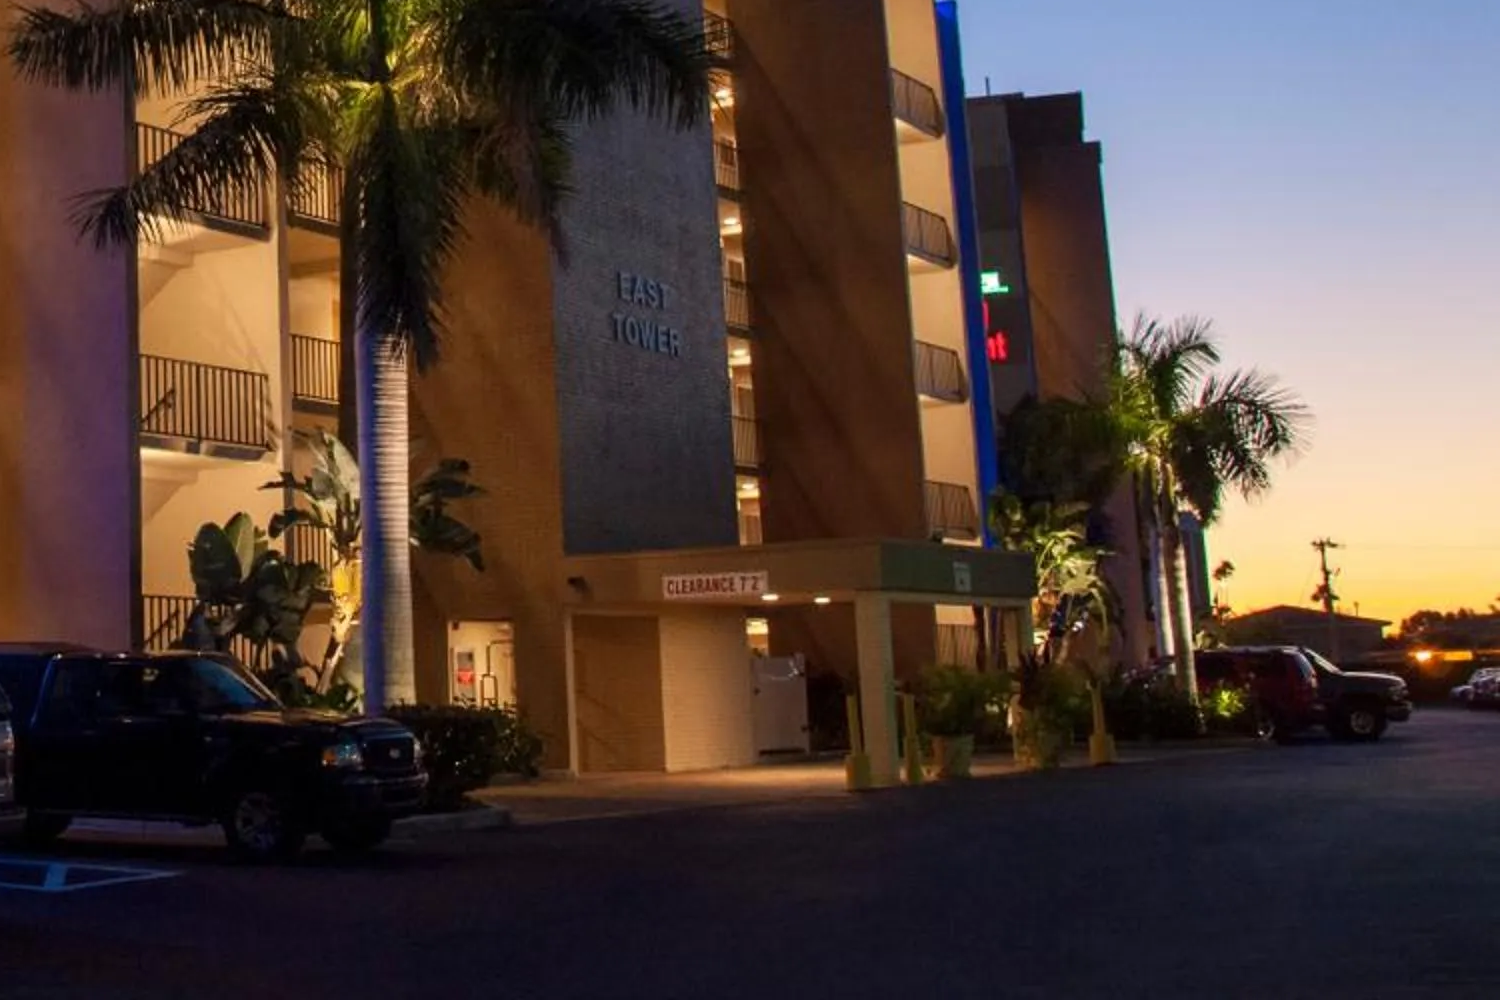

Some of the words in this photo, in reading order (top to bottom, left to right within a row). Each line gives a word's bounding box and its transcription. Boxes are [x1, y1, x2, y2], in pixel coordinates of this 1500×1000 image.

[617, 271, 672, 309] EAST
[611, 311, 681, 357] TOWER
[667, 577, 736, 595] CLEARANCE
